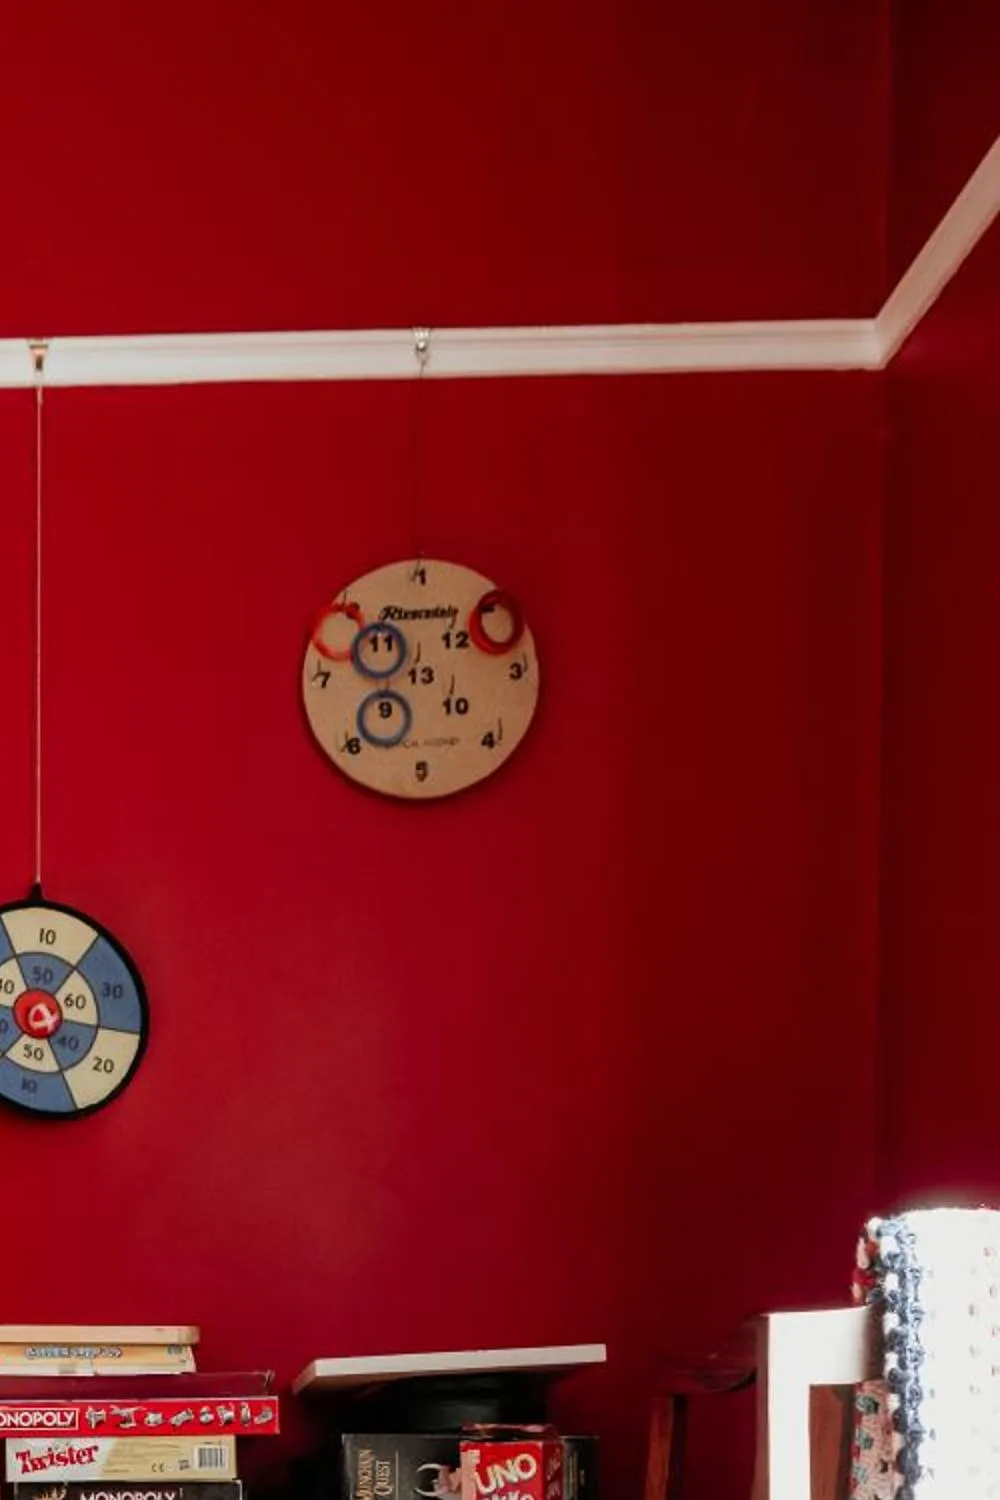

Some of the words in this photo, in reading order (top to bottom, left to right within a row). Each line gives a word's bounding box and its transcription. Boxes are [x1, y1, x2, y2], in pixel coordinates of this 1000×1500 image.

[370, 635, 393, 652] 11
[443, 632, 469, 649] 12
[317, 671, 331, 688] 7
[408, 667, 434, 684] 13
[510, 663, 523, 681] 3
[378, 702, 393, 718] 9
[443, 698, 469, 715] 10
[347, 738, 361, 755] 6
[481, 731, 495, 749] 4
[415, 761, 428, 778] 5
[39, 927, 56, 946] 10
[32, 966, 54, 984] 50
[102, 982, 124, 1000] 30
[64, 993, 86, 1011] 60
[57, 1034, 80, 1051] 40
[23, 1044, 45, 1062] 50
[92, 1056, 114, 1074] 20
[21, 1077, 38, 1095] 10
[15, 1445, 99, 1475] Twister
[474, 1453, 537, 1495] UNO
